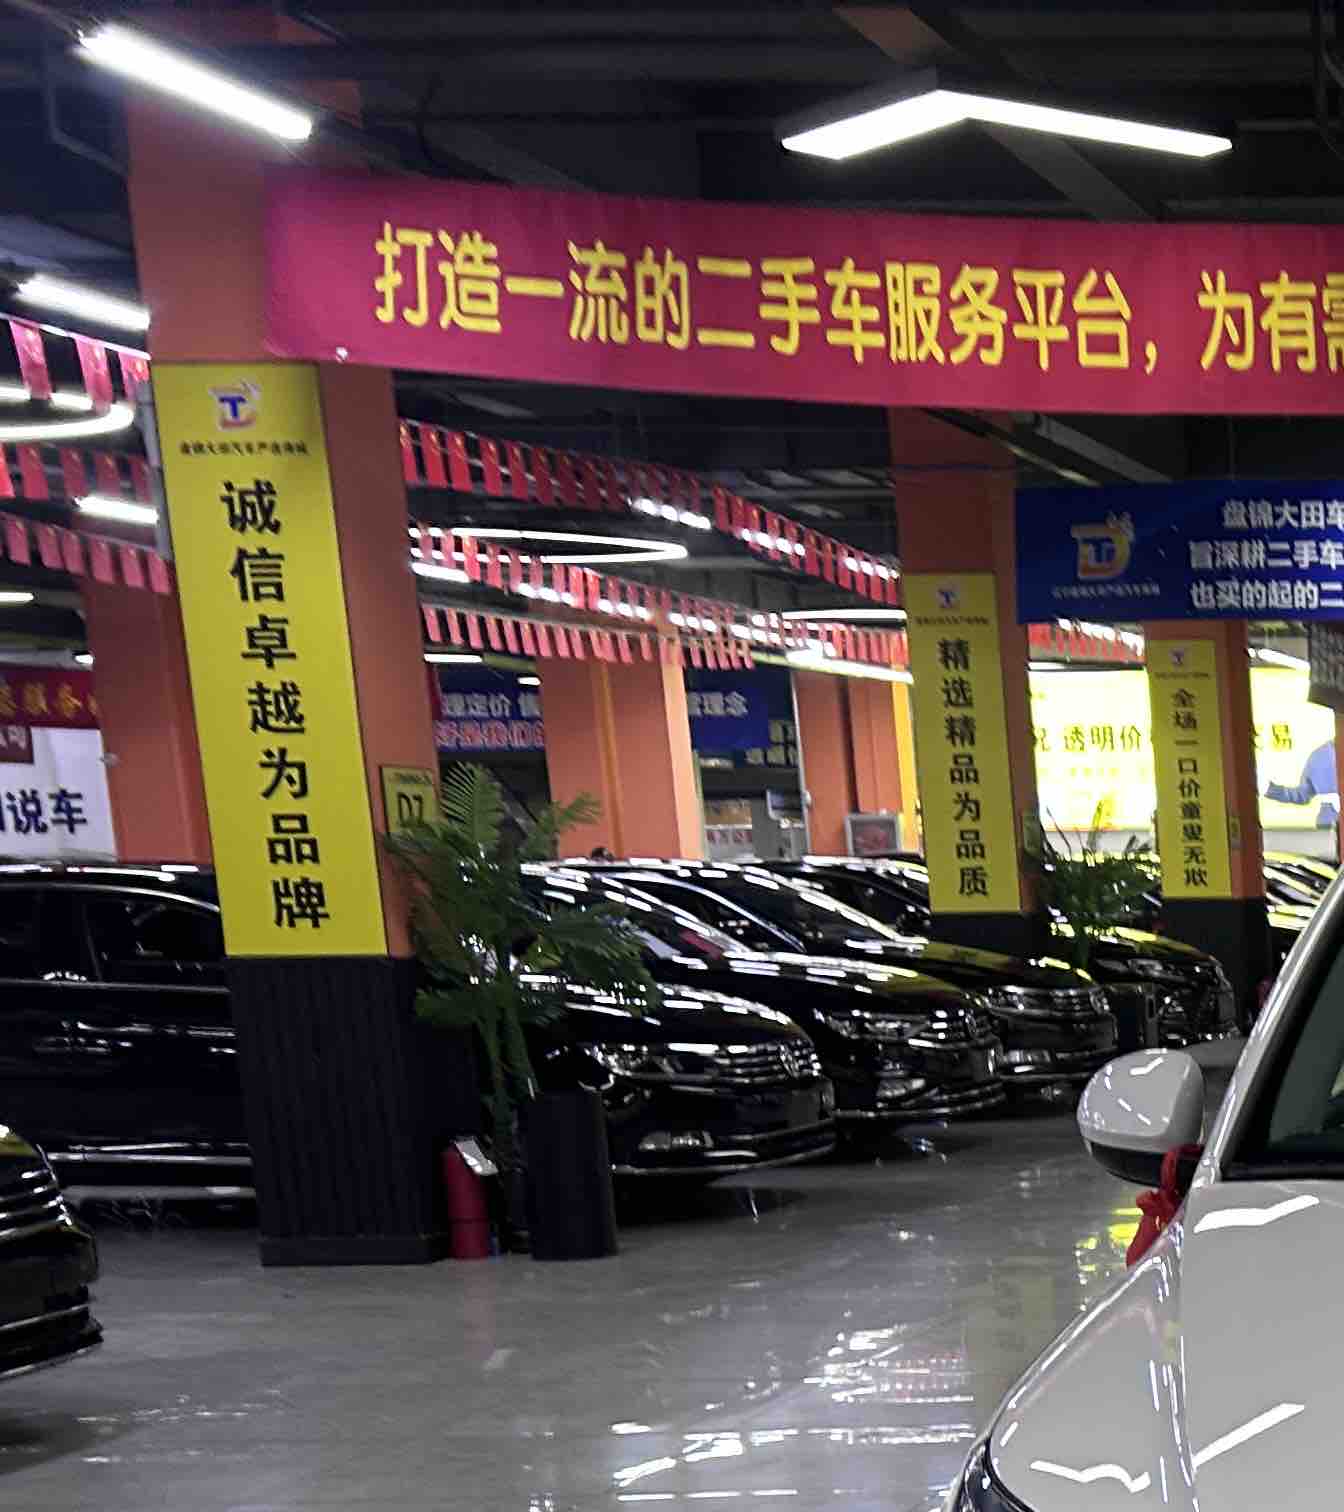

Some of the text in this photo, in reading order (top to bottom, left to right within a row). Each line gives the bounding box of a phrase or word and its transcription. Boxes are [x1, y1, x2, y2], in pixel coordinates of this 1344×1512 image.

[219, 479, 330, 930] 诚信卓越为品牌
[938, 637, 989, 897] 精选精品为品质
[1064, 725, 1142, 752] 透明价
[0, 786, 87, 835] 说车
